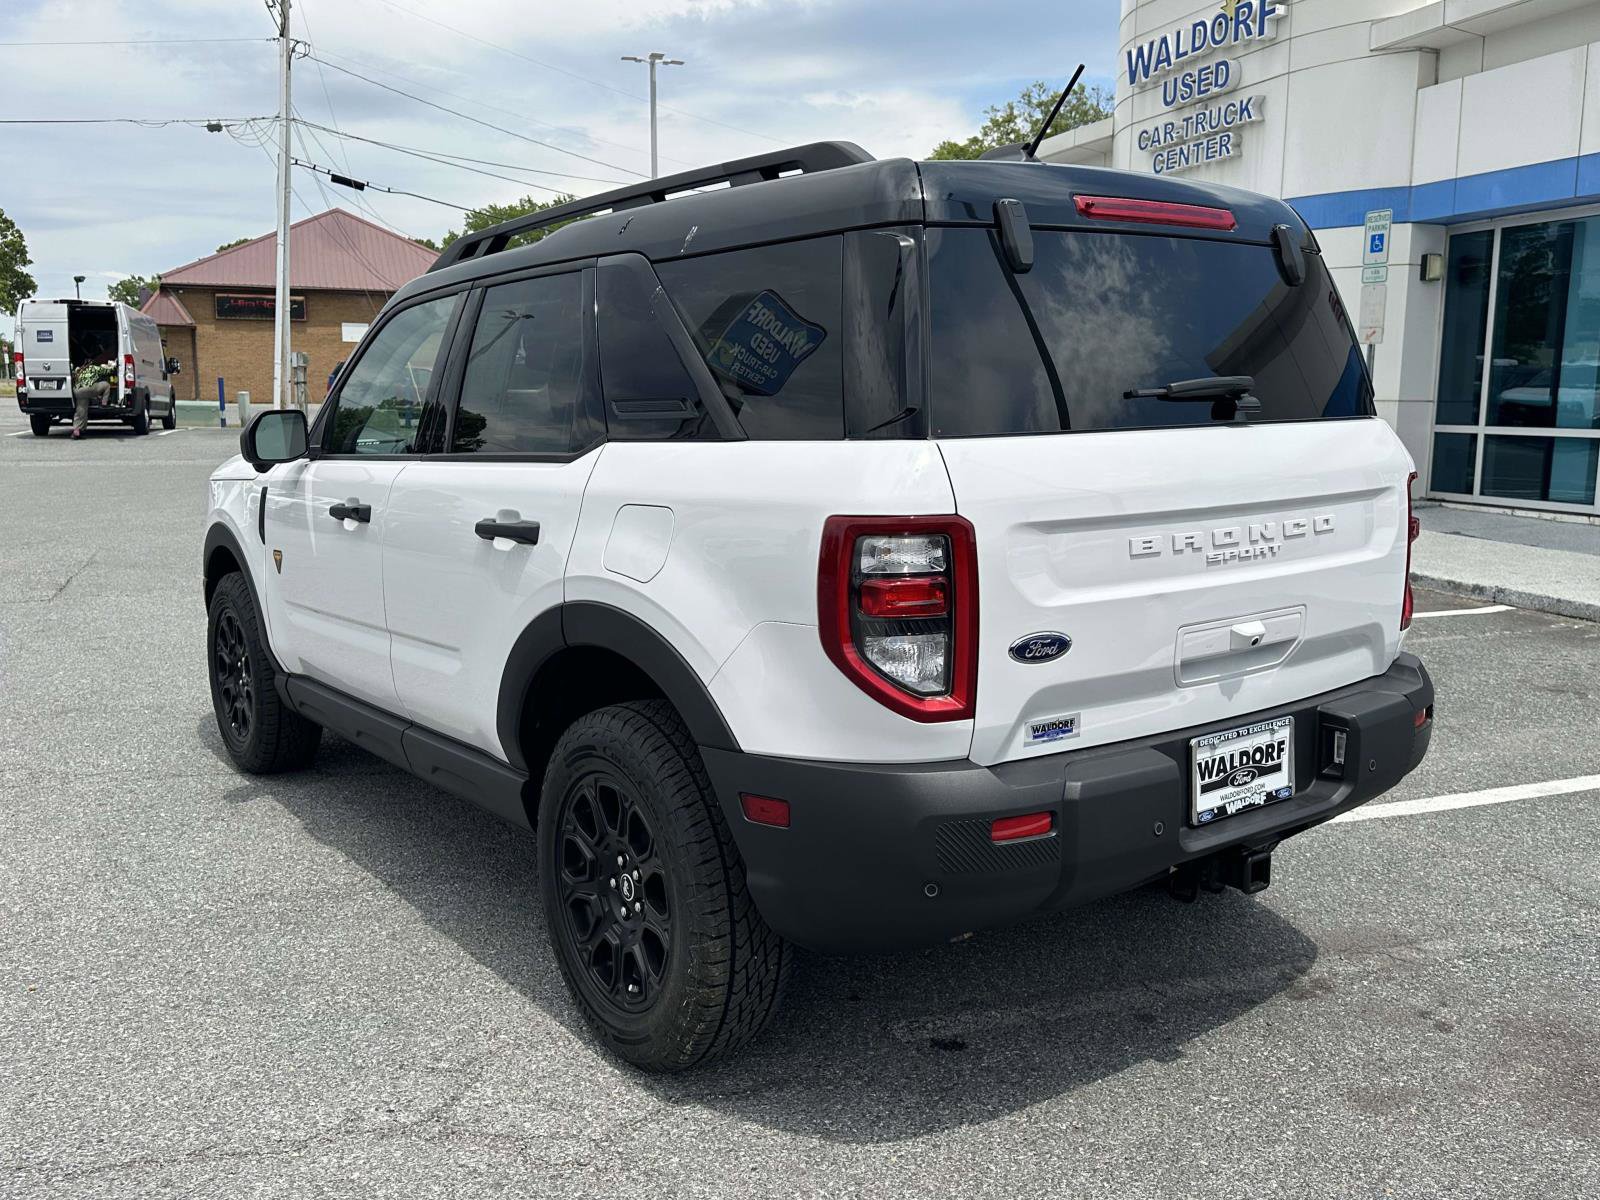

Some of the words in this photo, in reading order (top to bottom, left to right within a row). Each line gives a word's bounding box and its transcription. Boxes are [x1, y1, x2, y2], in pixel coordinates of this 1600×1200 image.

[1126, 0, 1277, 86] WALDORF
[1162, 59, 1231, 107] USED
[1137, 97, 1254, 151] CAR-TRUCK
[1153, 133, 1232, 174] CENTER
[1367, 223, 1389, 232] PARKING
[1129, 513, 1337, 560] BRONCO
[1206, 542, 1283, 566] SPORT
[1025, 638, 1060, 658] Ford
[1031, 717, 1075, 734] WALDORF
[1200, 731, 1238, 747] DEDICATED
[1239, 729, 1248, 737] TO
[1249, 718, 1290, 734] EXCELLENCE
[1197, 739, 1287, 782] WALDORF
[1233, 769, 1253, 786] Ford
[1225, 790, 1267, 815] WALDORF
